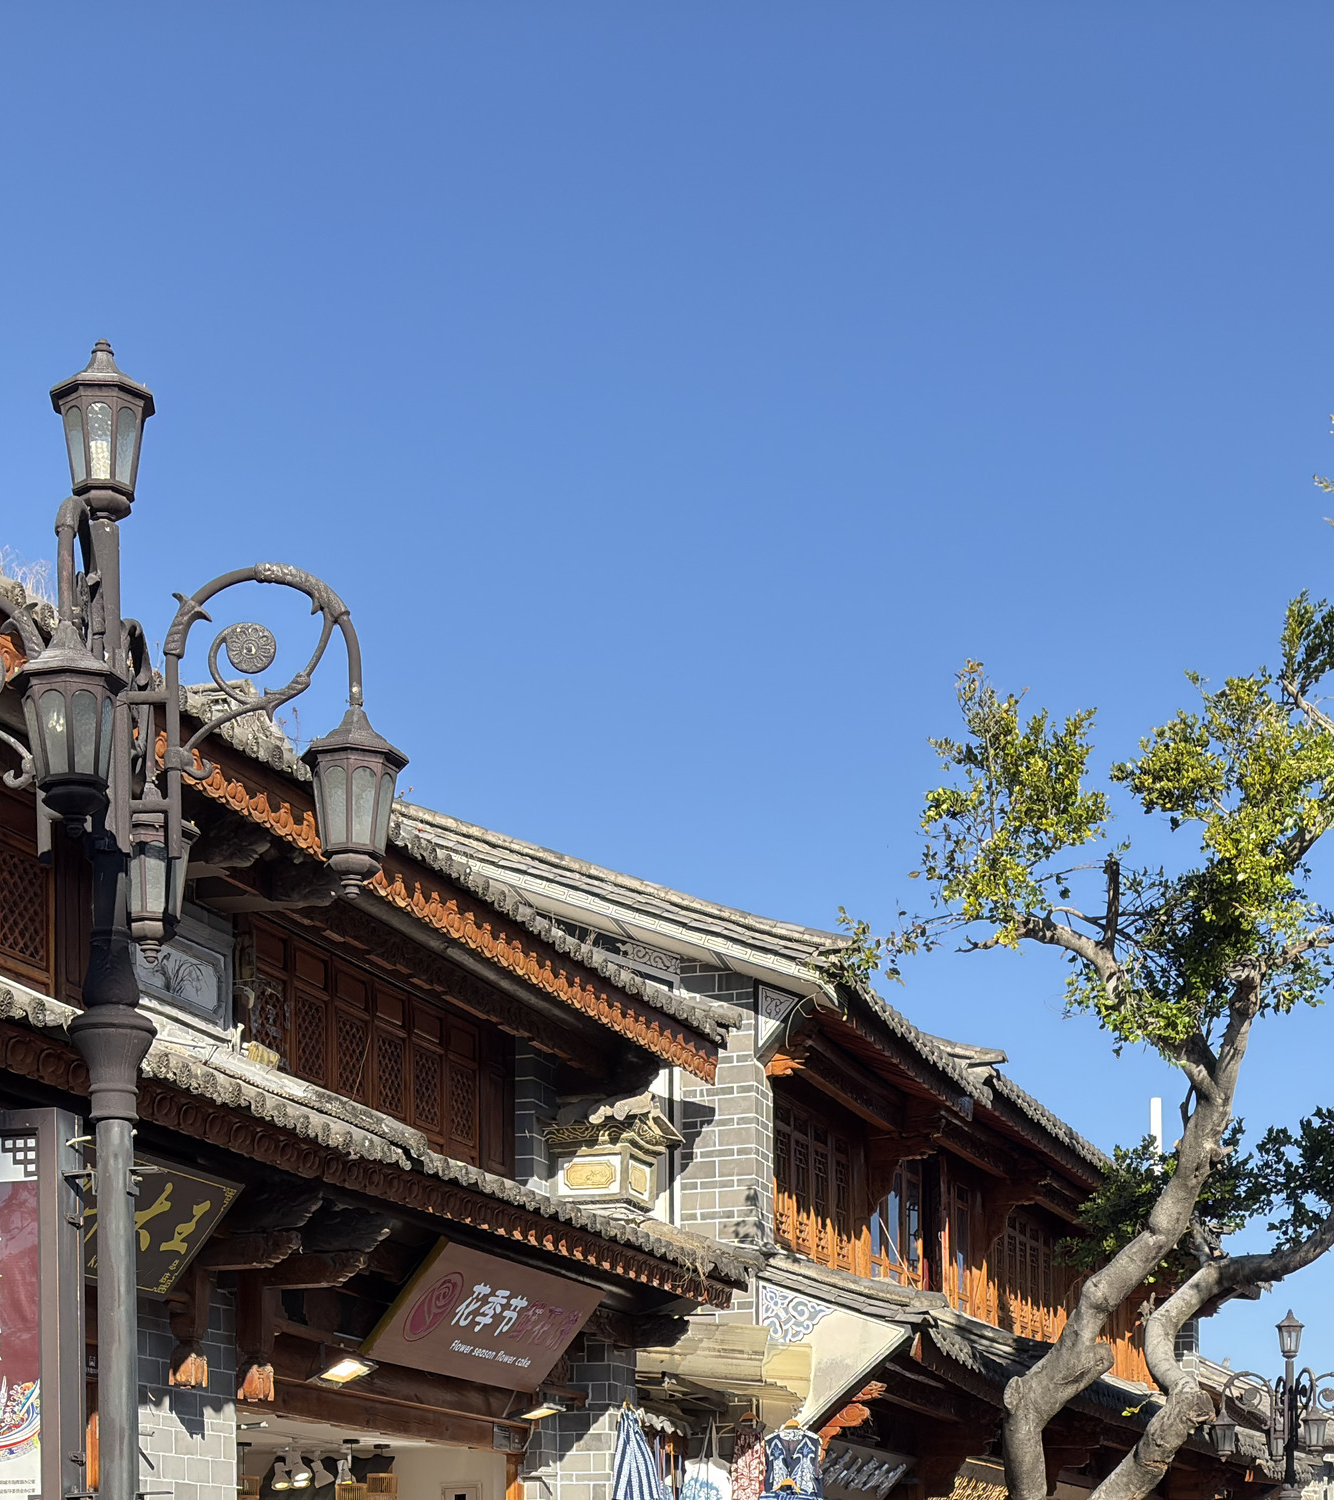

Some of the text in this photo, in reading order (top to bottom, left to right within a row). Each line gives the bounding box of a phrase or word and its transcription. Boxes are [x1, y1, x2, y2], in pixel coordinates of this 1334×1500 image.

[450, 1282, 529, 1337] 花季节
[449, 1339, 532, 1368] Flower season flower cake
